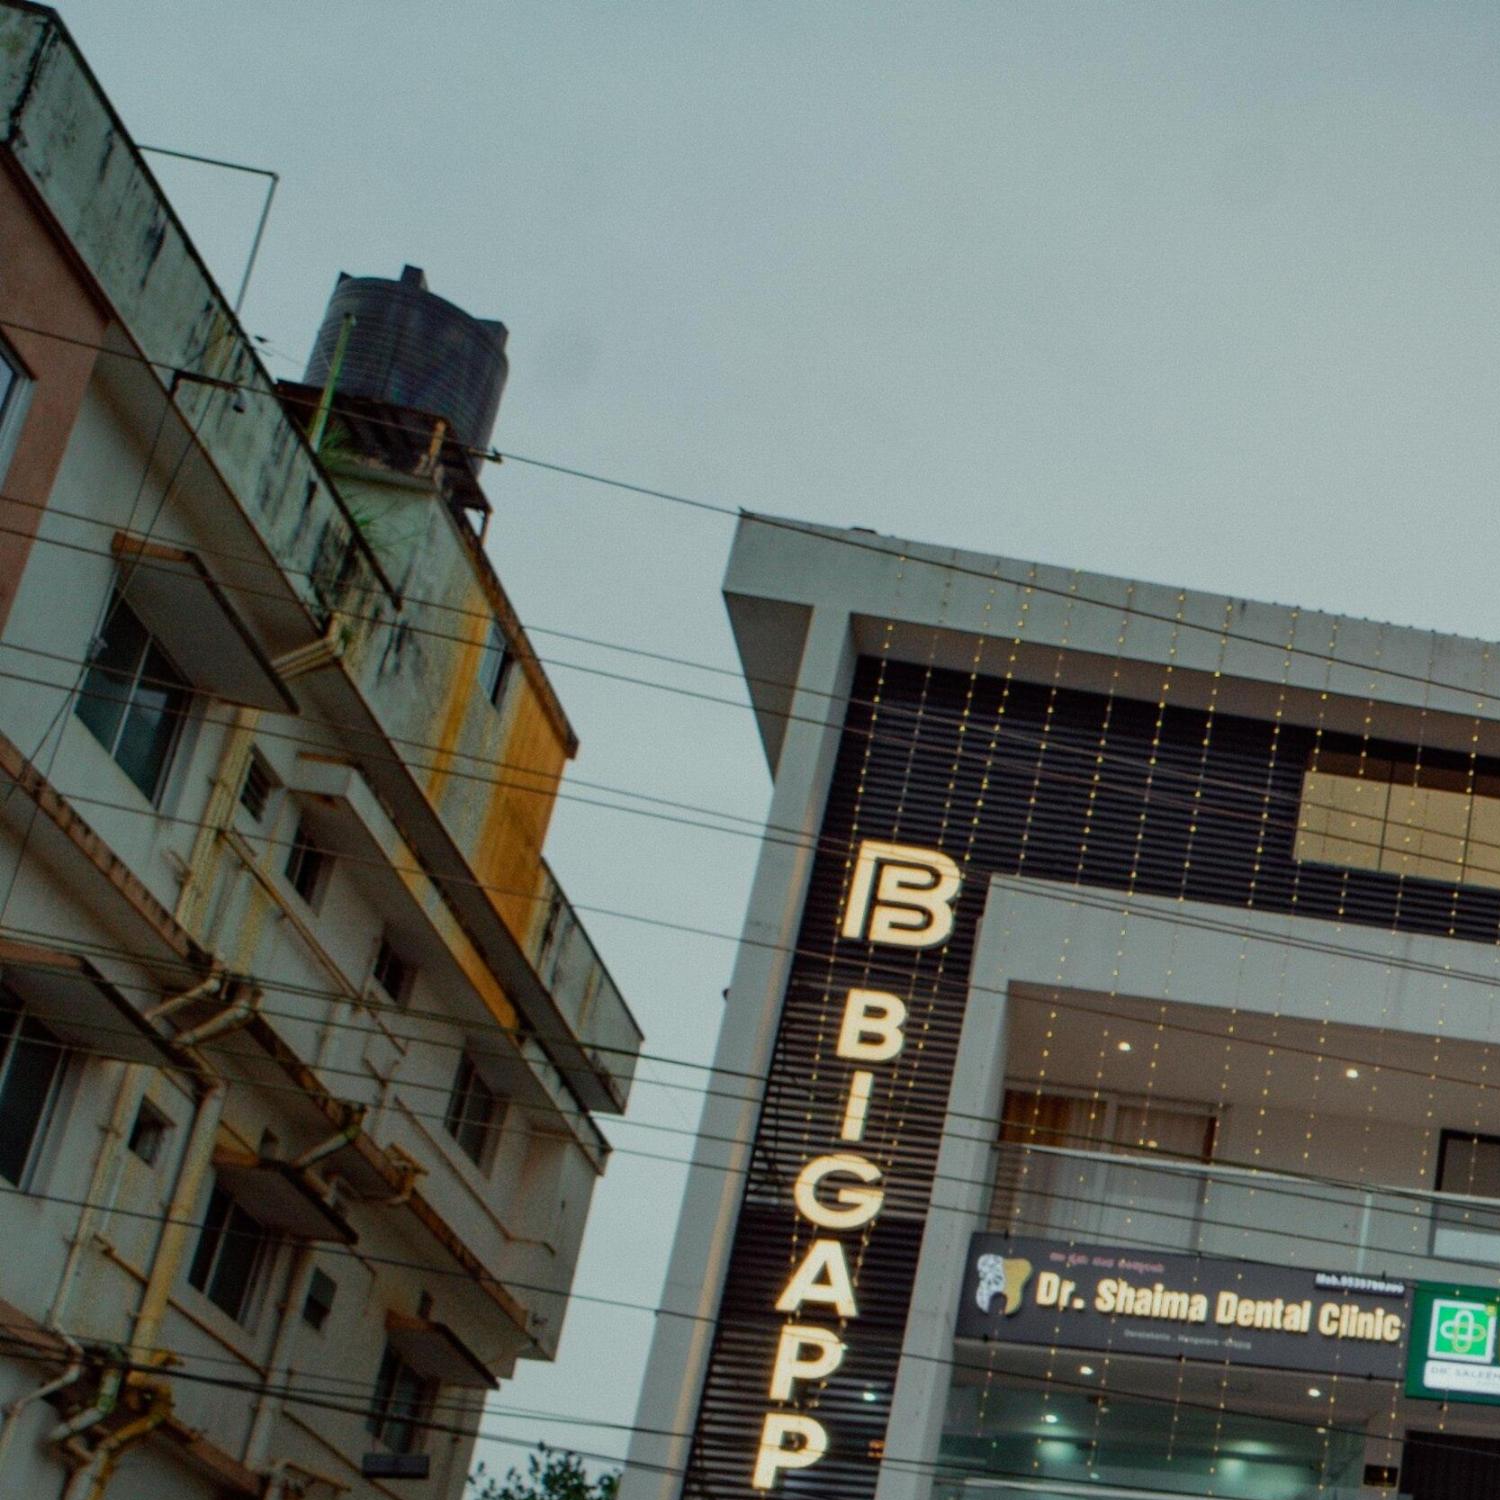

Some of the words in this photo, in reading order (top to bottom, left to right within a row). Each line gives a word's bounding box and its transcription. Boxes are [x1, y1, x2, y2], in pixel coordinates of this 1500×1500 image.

[1035, 1271, 1085, 1311] Dr.
[1095, 1277, 1208, 1324] Shaima
[1215, 1290, 1309, 1334] Dental
[1317, 1301, 1402, 1344] Clinic
